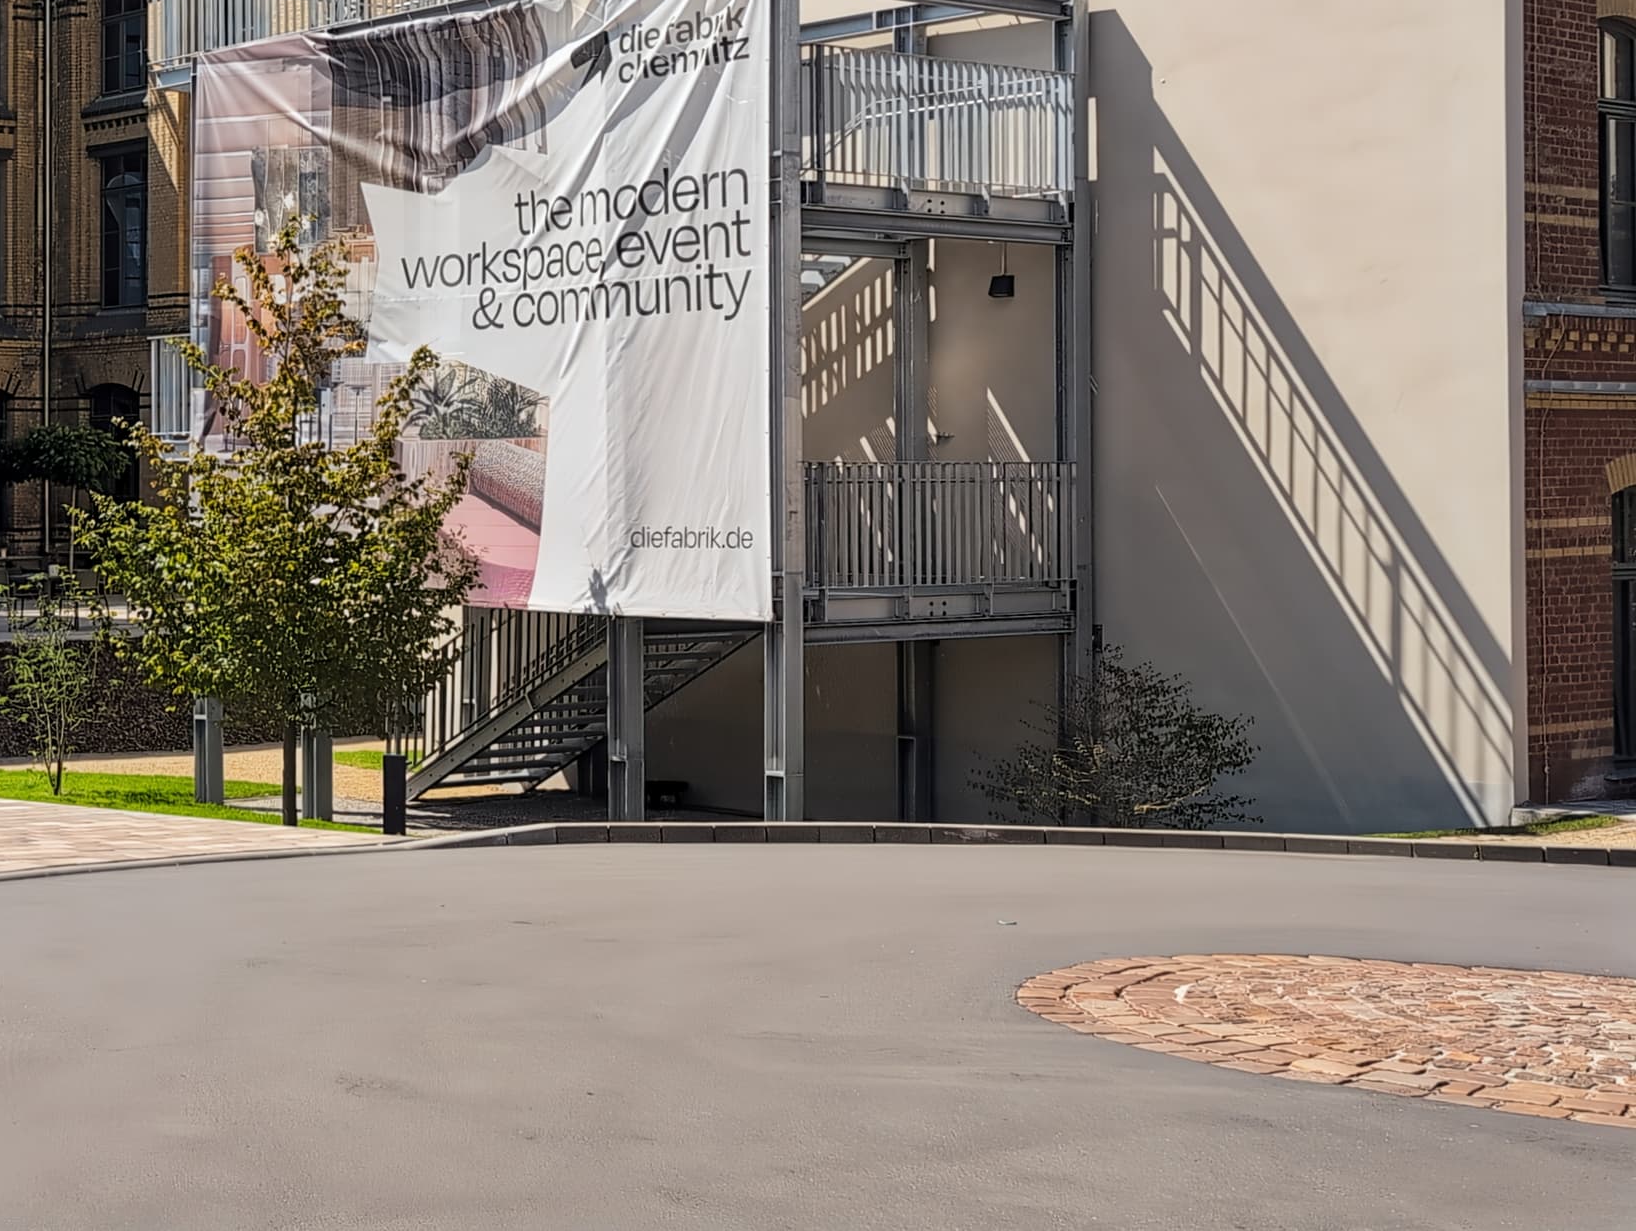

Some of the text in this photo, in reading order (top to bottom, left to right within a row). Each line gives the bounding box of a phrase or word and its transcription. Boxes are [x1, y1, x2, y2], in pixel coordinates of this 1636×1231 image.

[514, 167, 749, 235] the modern
[401, 209, 751, 291] workspace, event
[472, 263, 752, 330] & community
[630, 526, 754, 549] diefabrik.de
